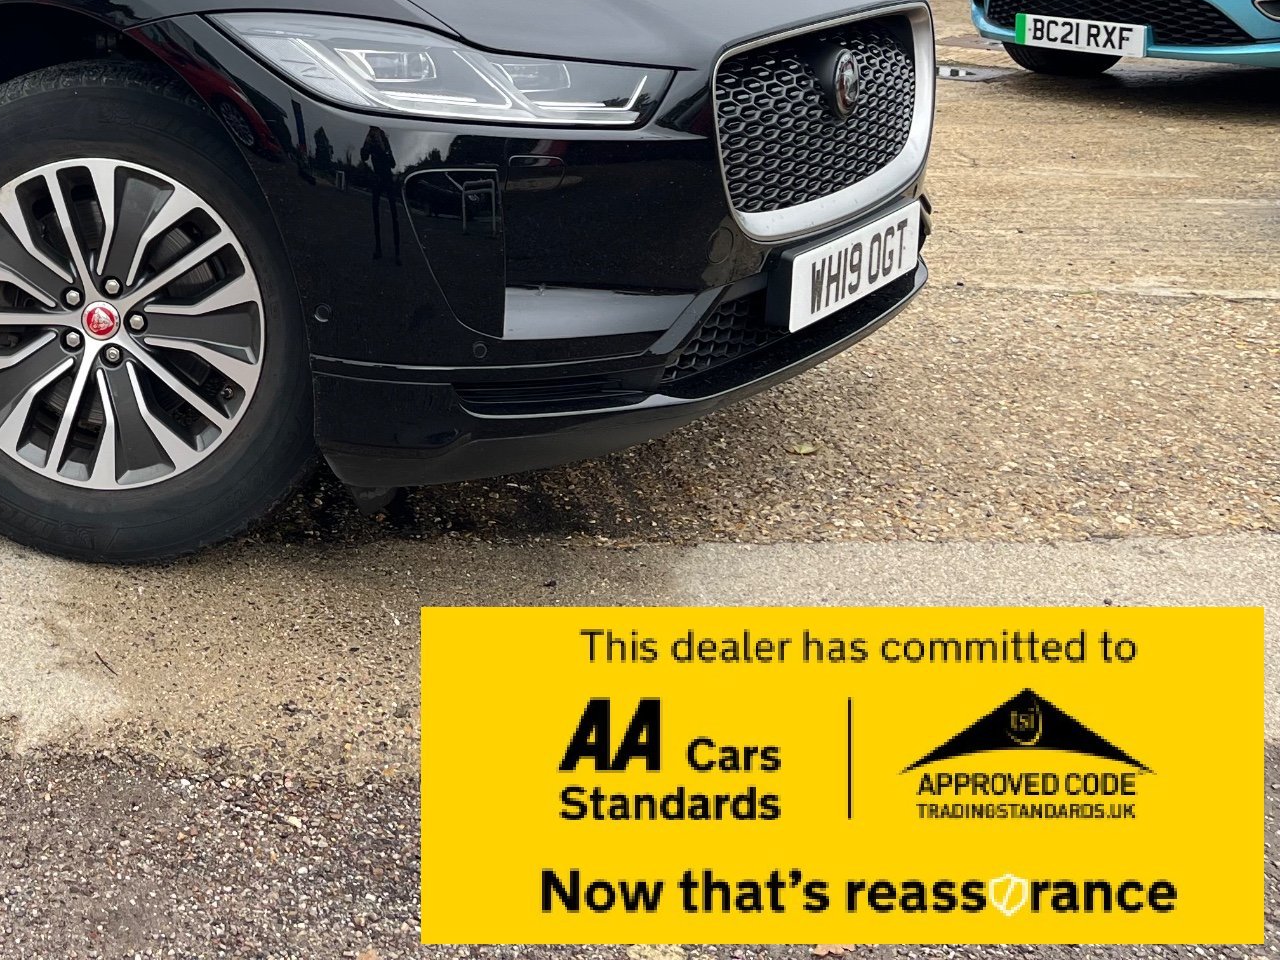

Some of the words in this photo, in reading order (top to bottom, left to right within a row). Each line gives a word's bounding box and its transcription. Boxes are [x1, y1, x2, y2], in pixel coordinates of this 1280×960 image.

[1032, 17, 1081, 46] BC21
[1086, 23, 1134, 50] RXF
[810, 241, 863, 315] WH19
[867, 217, 909, 285] OGT
